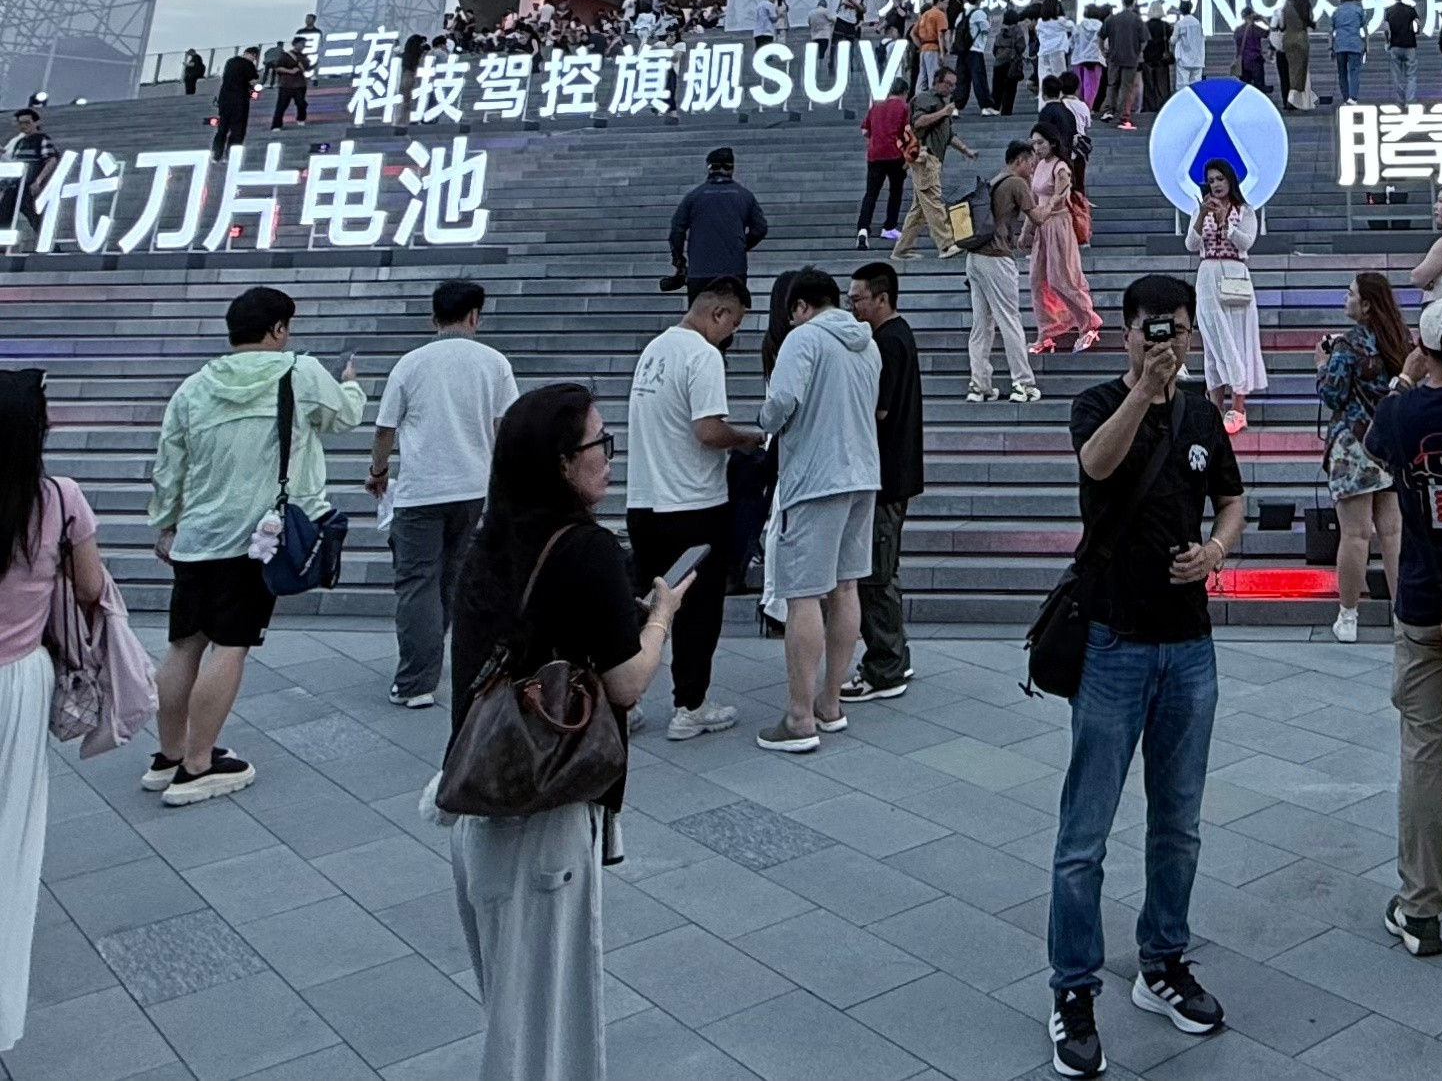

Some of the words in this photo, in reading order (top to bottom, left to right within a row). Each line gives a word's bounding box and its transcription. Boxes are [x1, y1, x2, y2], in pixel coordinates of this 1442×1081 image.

[347, 38, 909, 125] 科技驾控旗舰SUV
